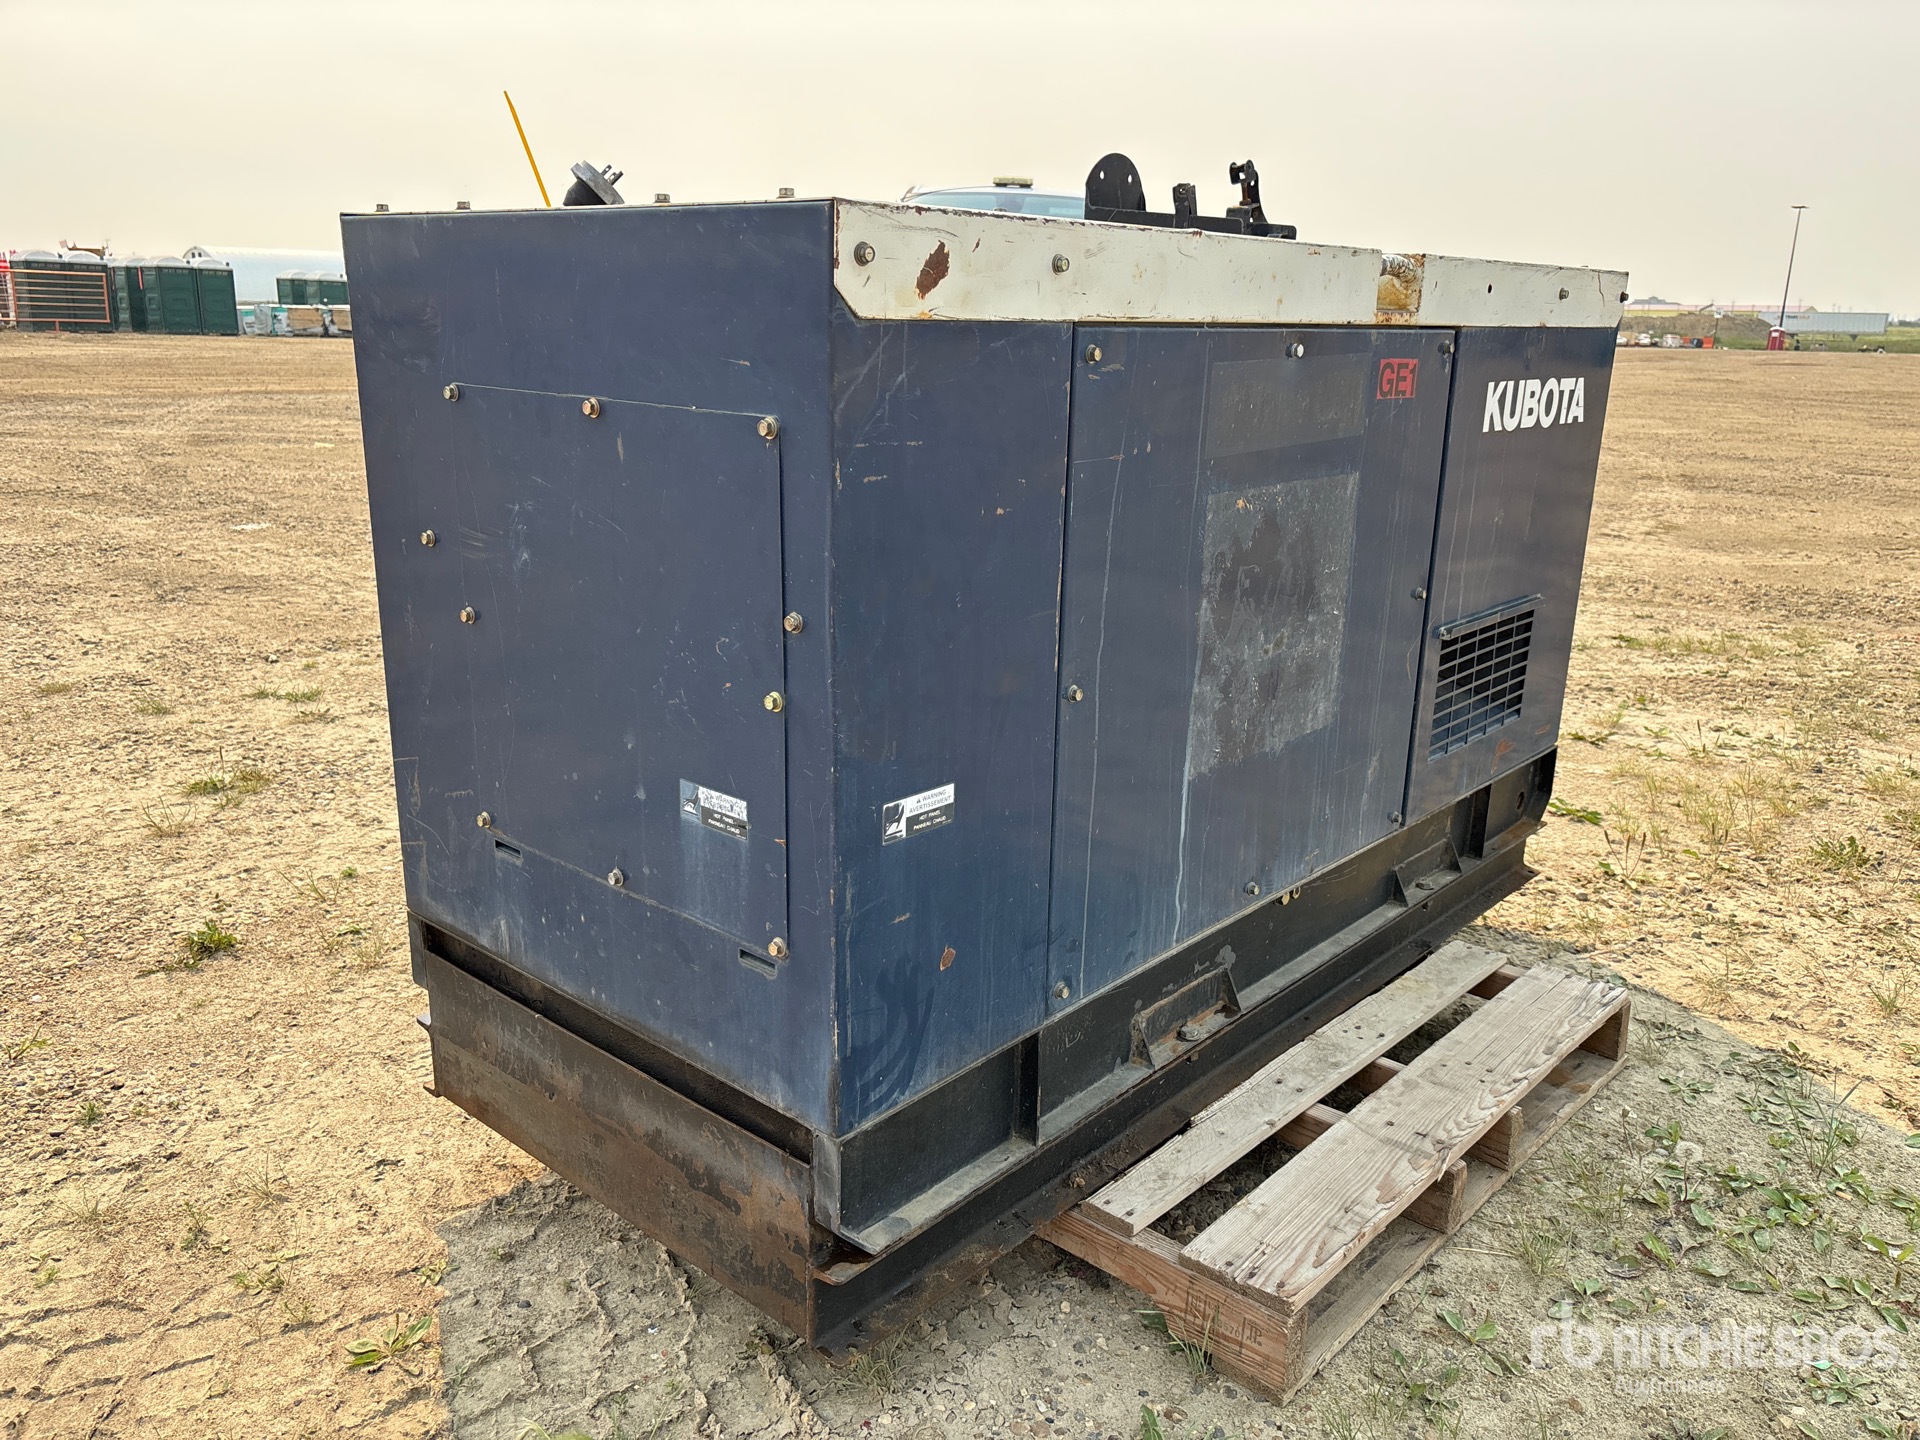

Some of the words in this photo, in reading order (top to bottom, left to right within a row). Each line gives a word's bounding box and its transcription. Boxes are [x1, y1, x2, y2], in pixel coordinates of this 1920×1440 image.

[1482, 377, 1585, 433] KUBOTA
[909, 795, 952, 814] AVERTISSEMENT
[922, 789, 947, 802] WARNING
